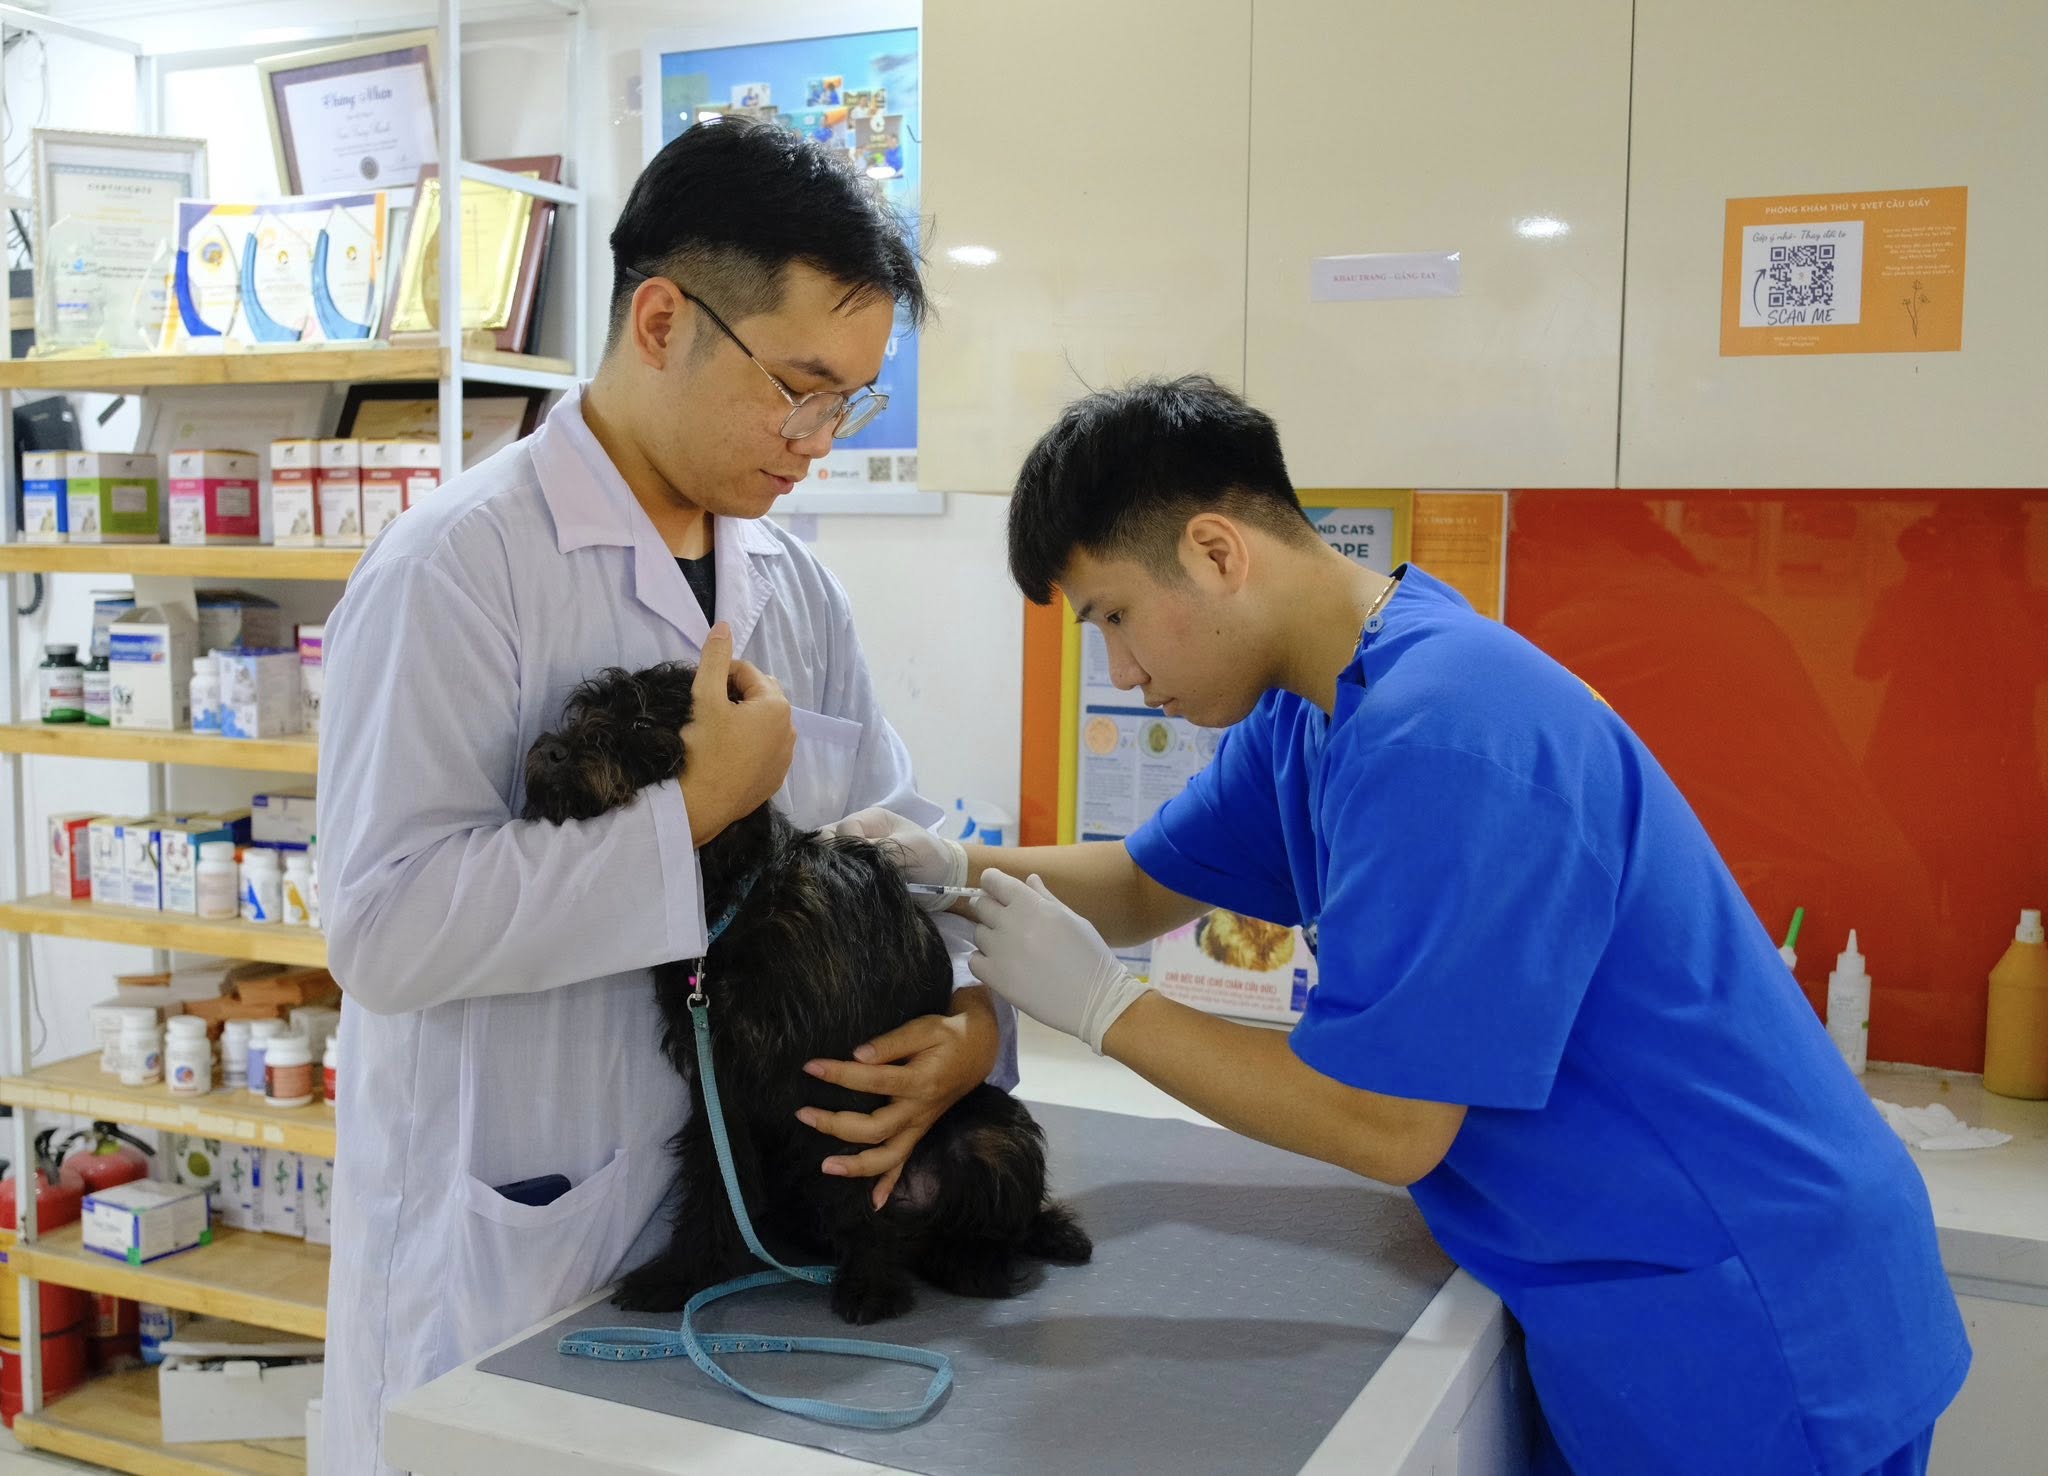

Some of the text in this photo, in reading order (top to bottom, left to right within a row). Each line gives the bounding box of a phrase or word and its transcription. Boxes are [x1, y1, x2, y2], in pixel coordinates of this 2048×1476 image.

[1800, 203, 1828, 214] KHÁM
[1830, 202, 1849, 212] THÚ
[1851, 203, 1859, 211] Y
[1800, 230, 1822, 241] Thay
[1359, 272, 1387, 281] TRANG
[1420, 271, 1438, 281] TAY
[1768, 308, 1836, 326] SCAN ME
[1317, 524, 1375, 535] ND CATS
[1330, 543, 1369, 558] OPE
